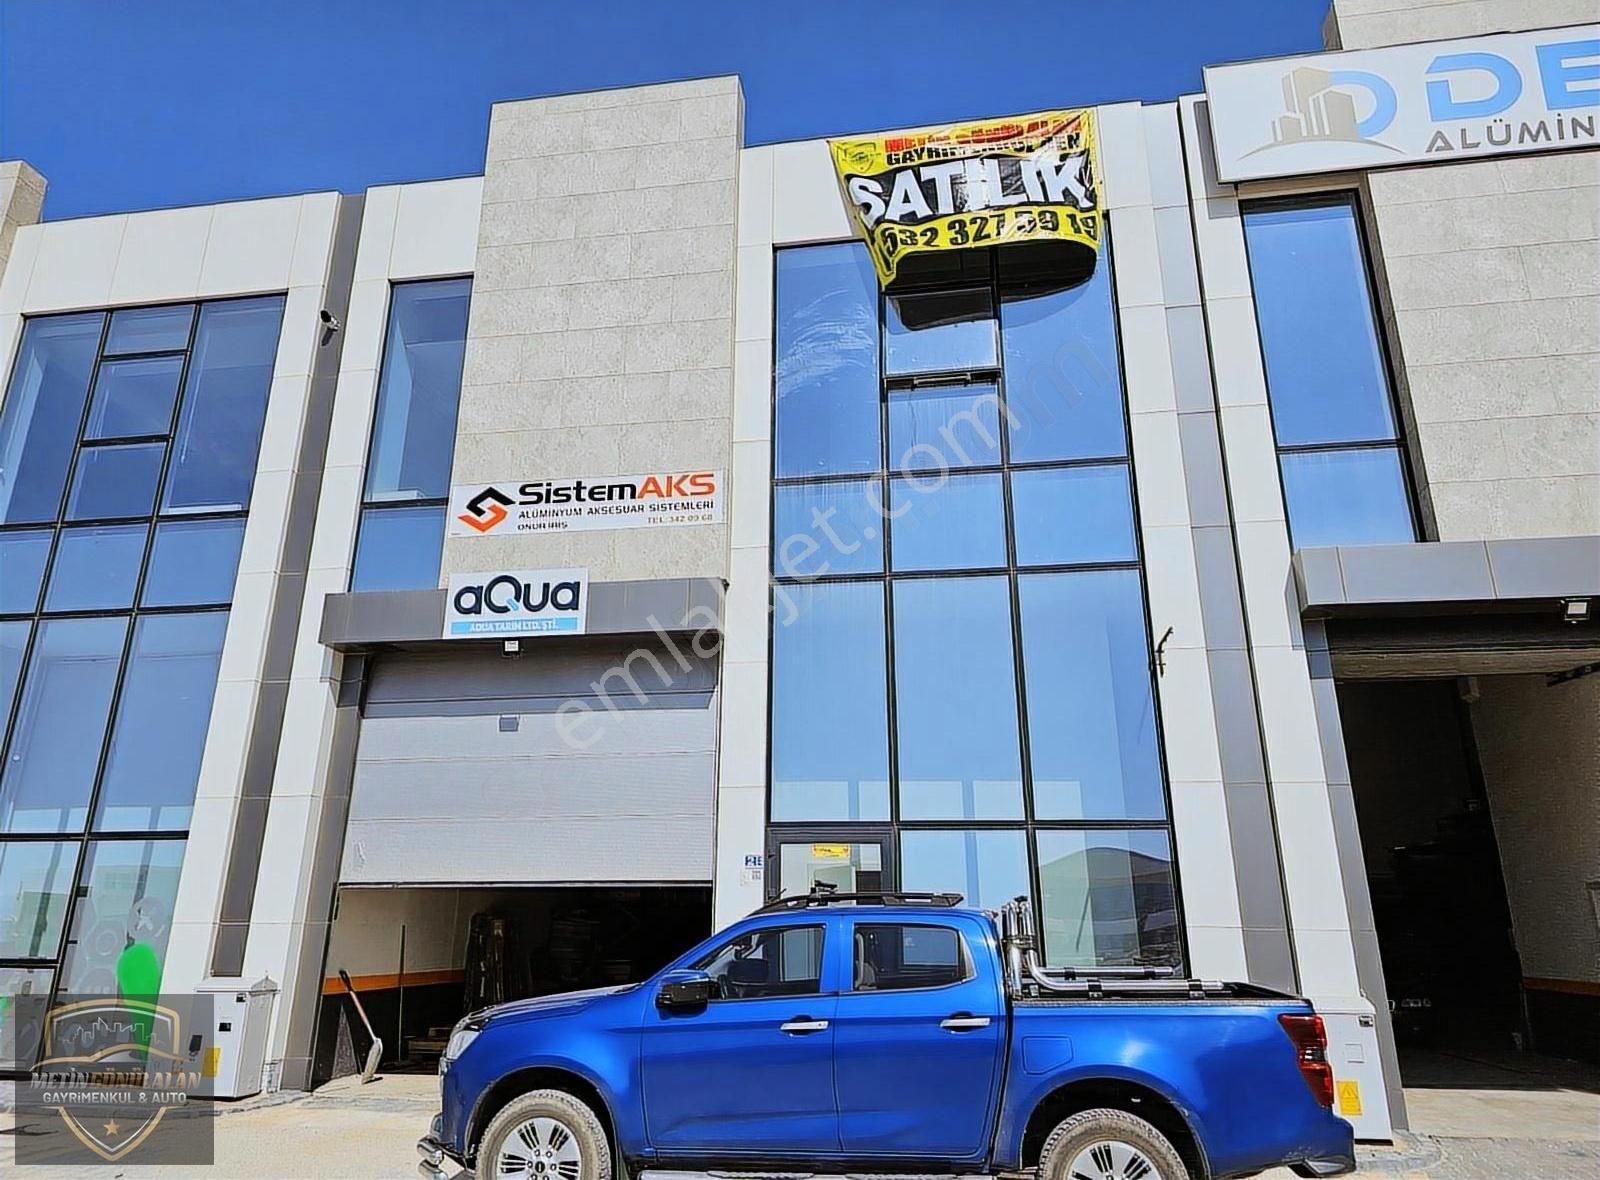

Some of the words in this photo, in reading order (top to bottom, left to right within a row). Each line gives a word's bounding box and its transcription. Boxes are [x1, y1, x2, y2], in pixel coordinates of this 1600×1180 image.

[1425, 113, 1595, 153] ALÜMİN
[848, 150, 1094, 232] SATILIK
[947, 213, 1005, 246] 327
[518, 473, 715, 506] SistemAKS
[587, 504, 645, 516] AKSESUAR
